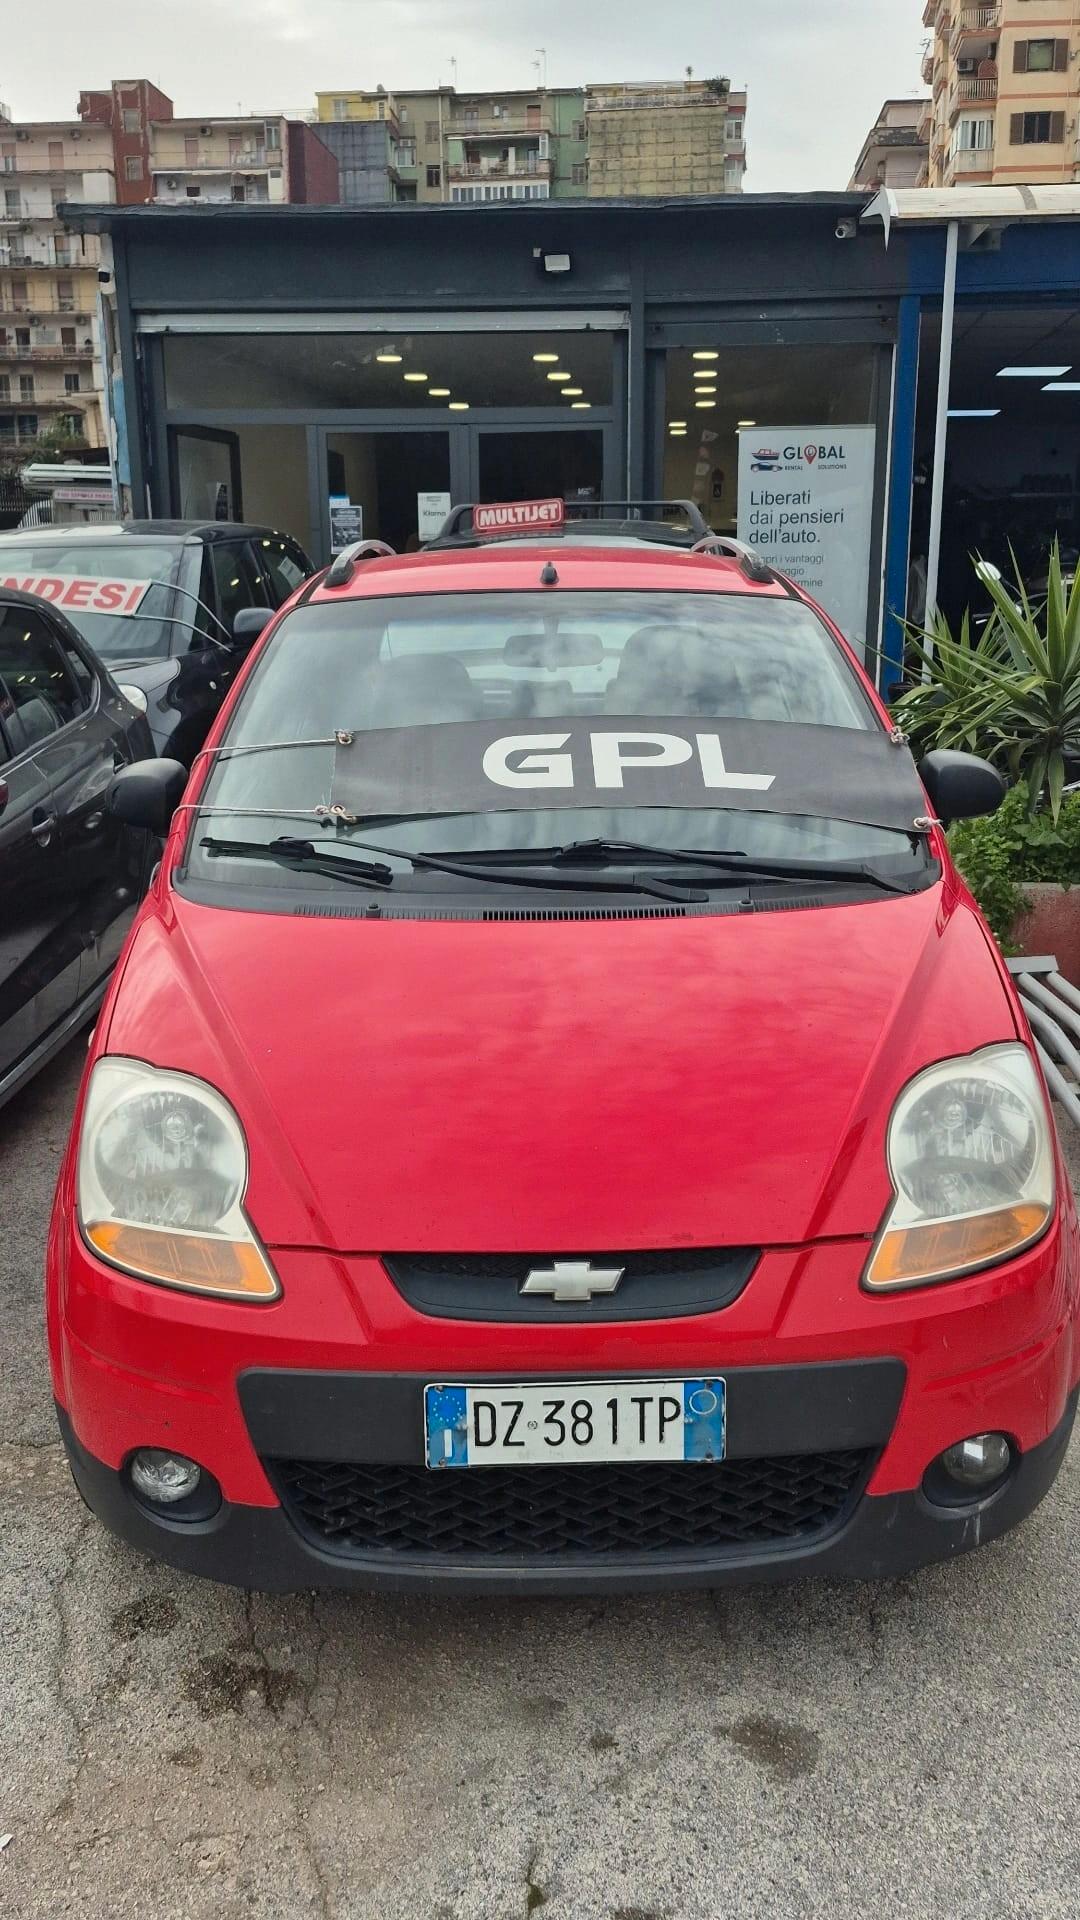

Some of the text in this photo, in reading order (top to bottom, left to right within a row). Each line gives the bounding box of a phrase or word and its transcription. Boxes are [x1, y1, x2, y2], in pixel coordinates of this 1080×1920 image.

[783, 445, 846, 462] GLOBAL
[750, 490, 811, 506] Liberati
[480, 503, 559, 527] MULTIJET
[749, 507, 844, 528] dai pensieri
[749, 528, 821, 544] dell'auto.
[784, 554, 824, 565] vantaggi
[483, 732, 776, 791] GPL
[473, 1400, 525, 1447] DZ
[542, 1396, 681, 1446] 381TP
